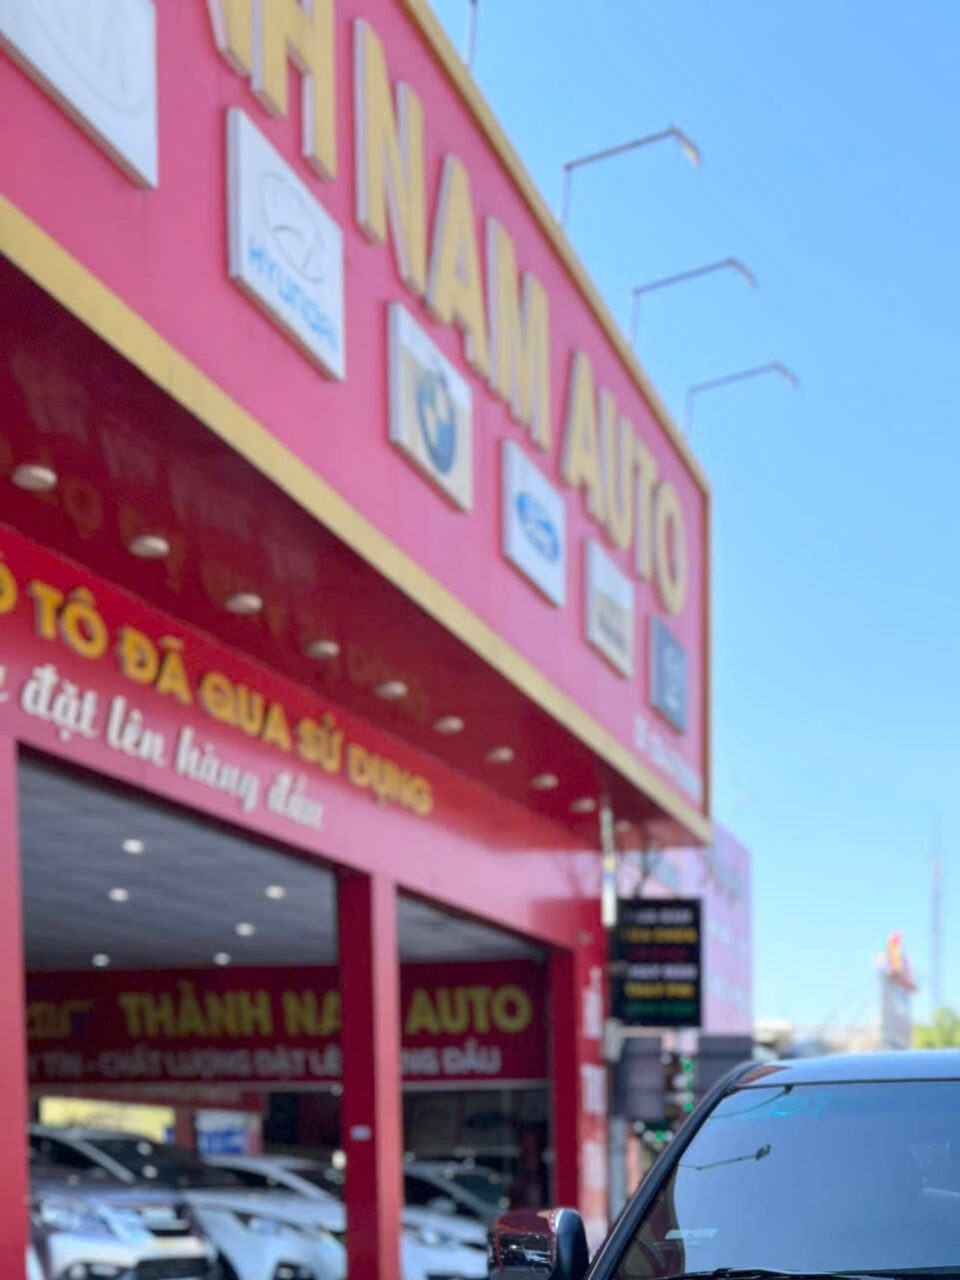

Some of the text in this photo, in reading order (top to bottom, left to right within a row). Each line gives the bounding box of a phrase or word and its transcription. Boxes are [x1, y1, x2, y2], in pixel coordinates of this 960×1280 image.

[353, 17, 550, 453] NAM
[560, 351, 687, 616] AUTO
[21, 663, 99, 742] đặt
[28, 578, 109, 659] TÔ
[118, 625, 193, 706] ĐÃ
[201, 672, 291, 750] QUA
[118, 980, 272, 1038] THÀNH
[282, 988, 342, 1037] NA
[405, 984, 533, 1036] AUTO
